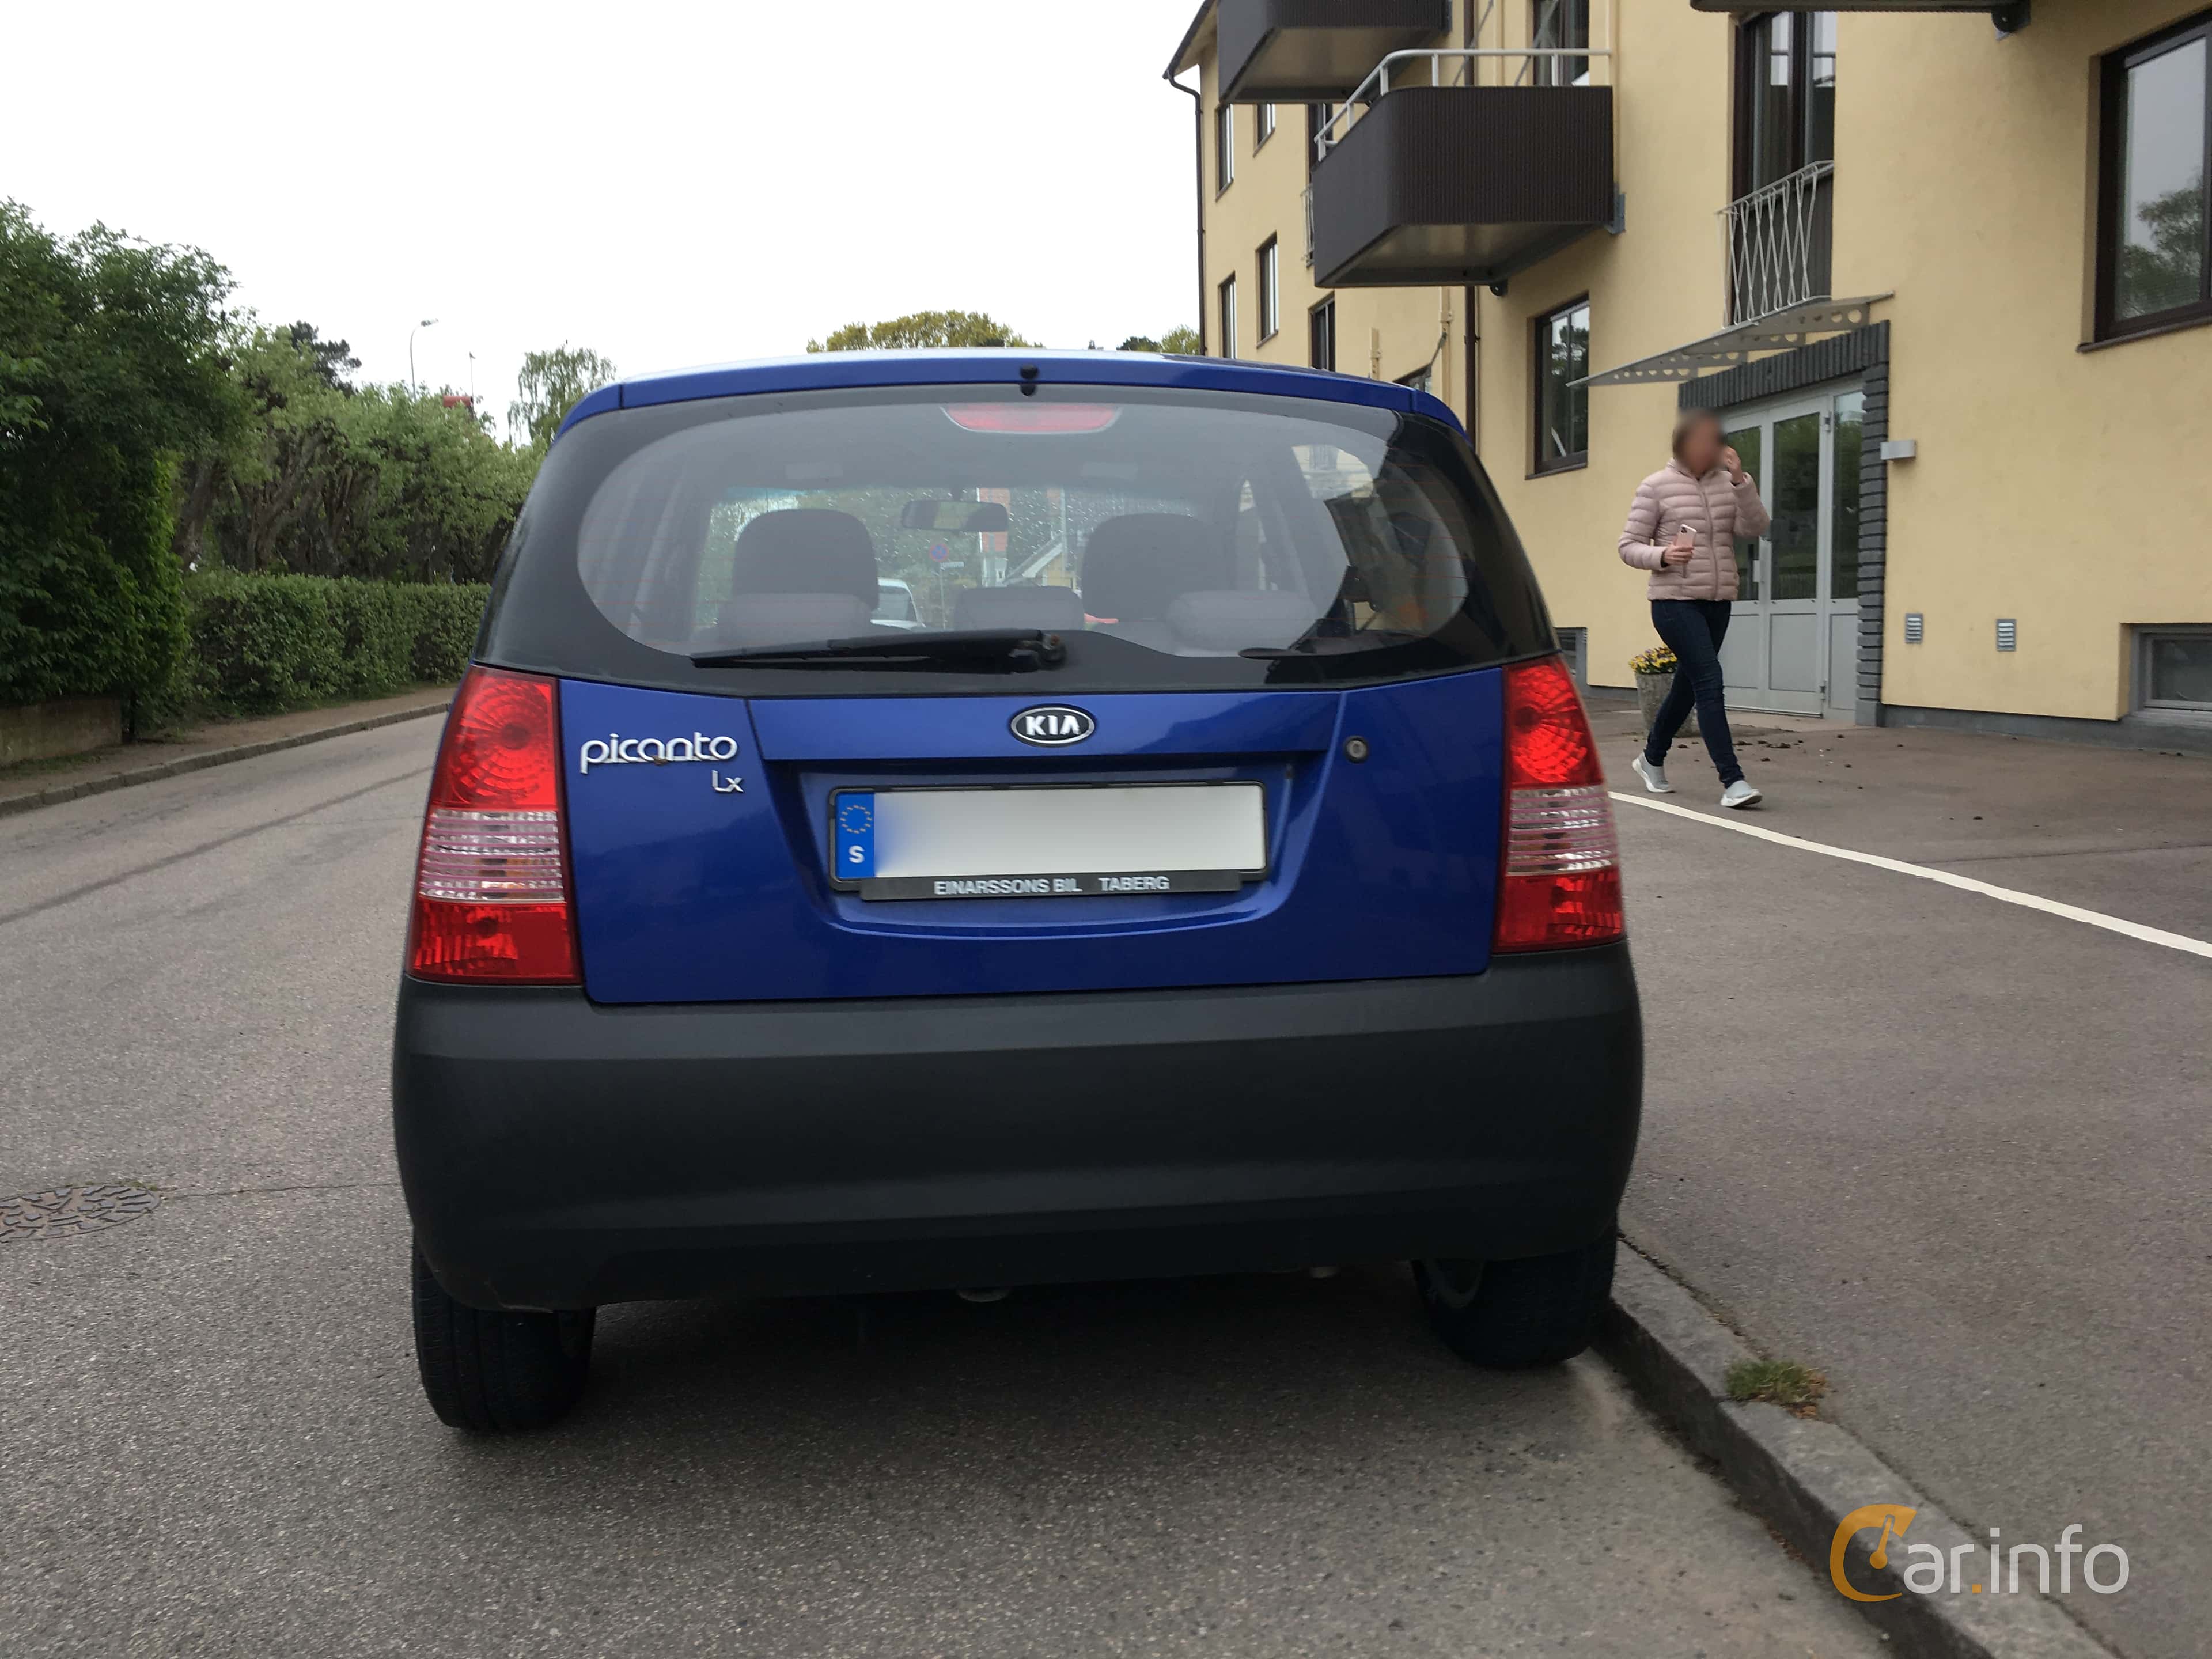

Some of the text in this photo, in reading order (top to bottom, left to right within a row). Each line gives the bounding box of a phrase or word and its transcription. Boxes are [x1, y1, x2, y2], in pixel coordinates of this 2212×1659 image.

[1024, 715, 1081, 736] KIA
[579, 732, 738, 774] picanto
[848, 844, 865, 863] S
[934, 876, 1171, 895] EINARSSONS BIL TABERG
